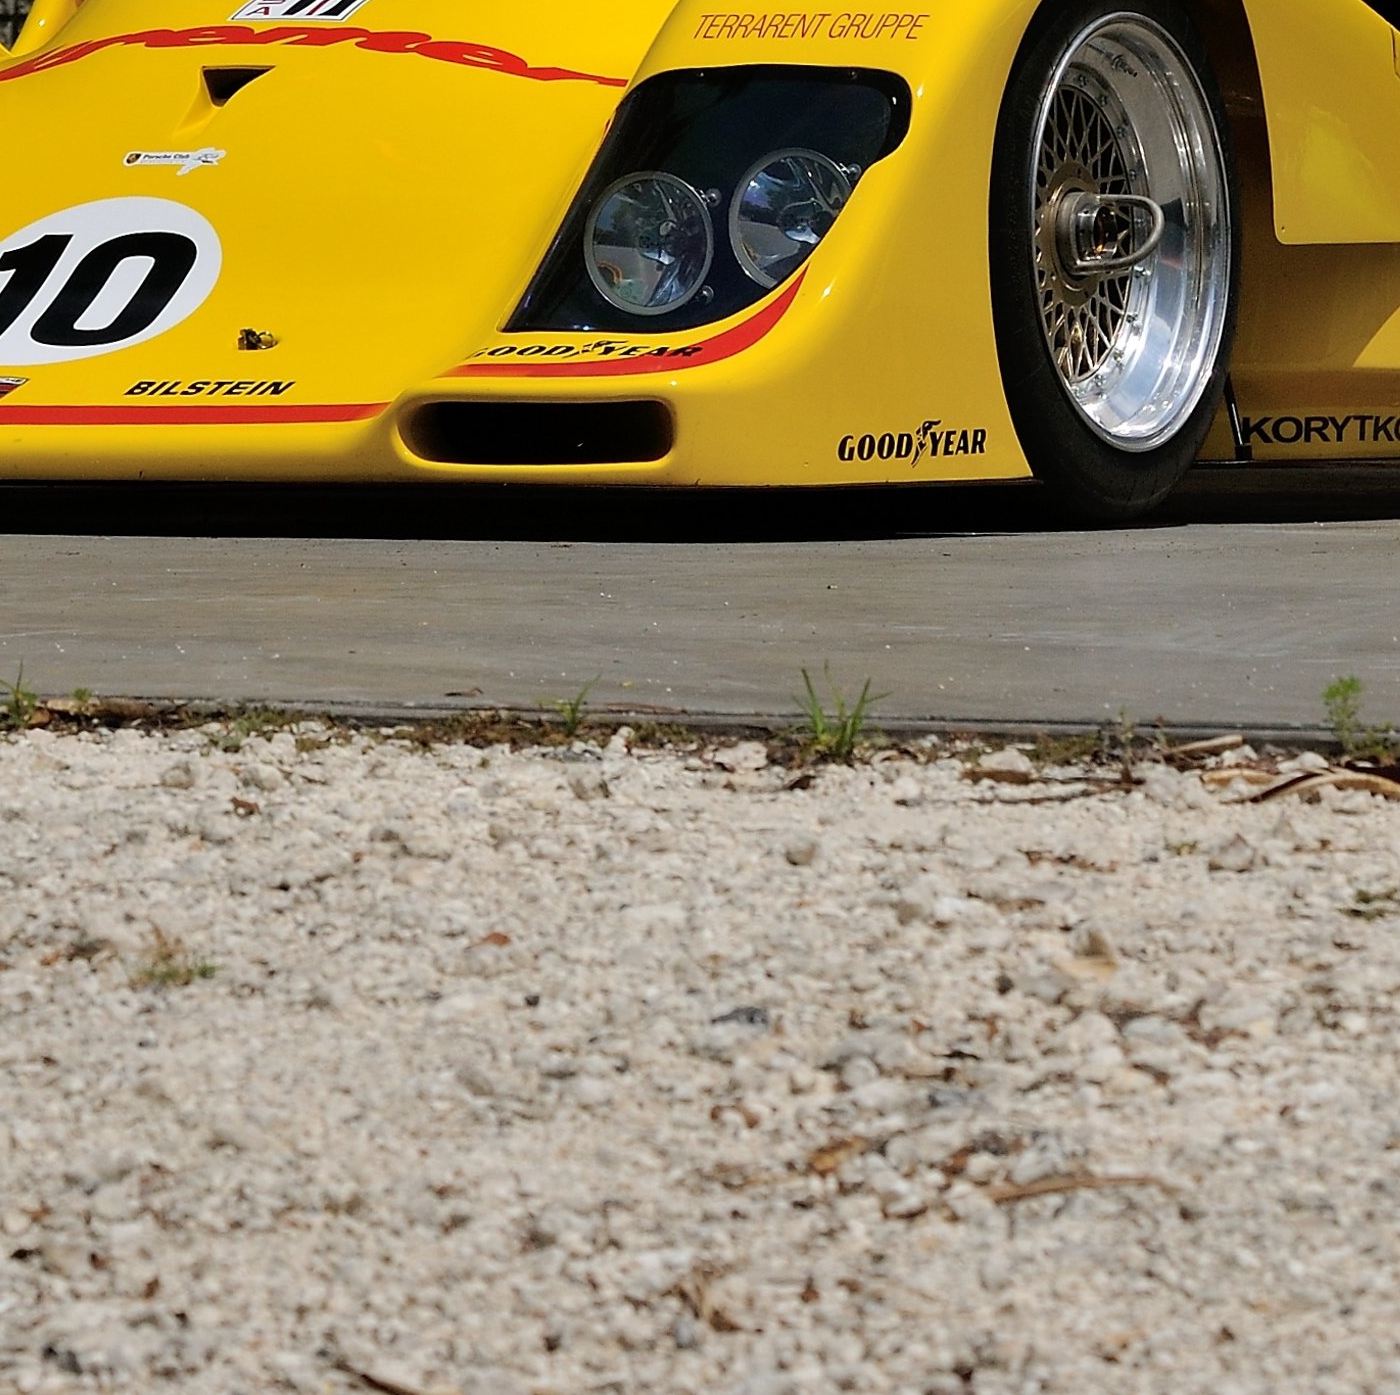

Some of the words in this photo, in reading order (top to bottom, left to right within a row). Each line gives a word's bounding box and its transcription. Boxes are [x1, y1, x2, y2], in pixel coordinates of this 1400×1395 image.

[692, 13, 831, 40] TERRARENT
[828, 12, 931, 40] GRUPPE
[123, 380, 296, 396] BILSTEIN
[837, 419, 987, 468] GOODYEAR
